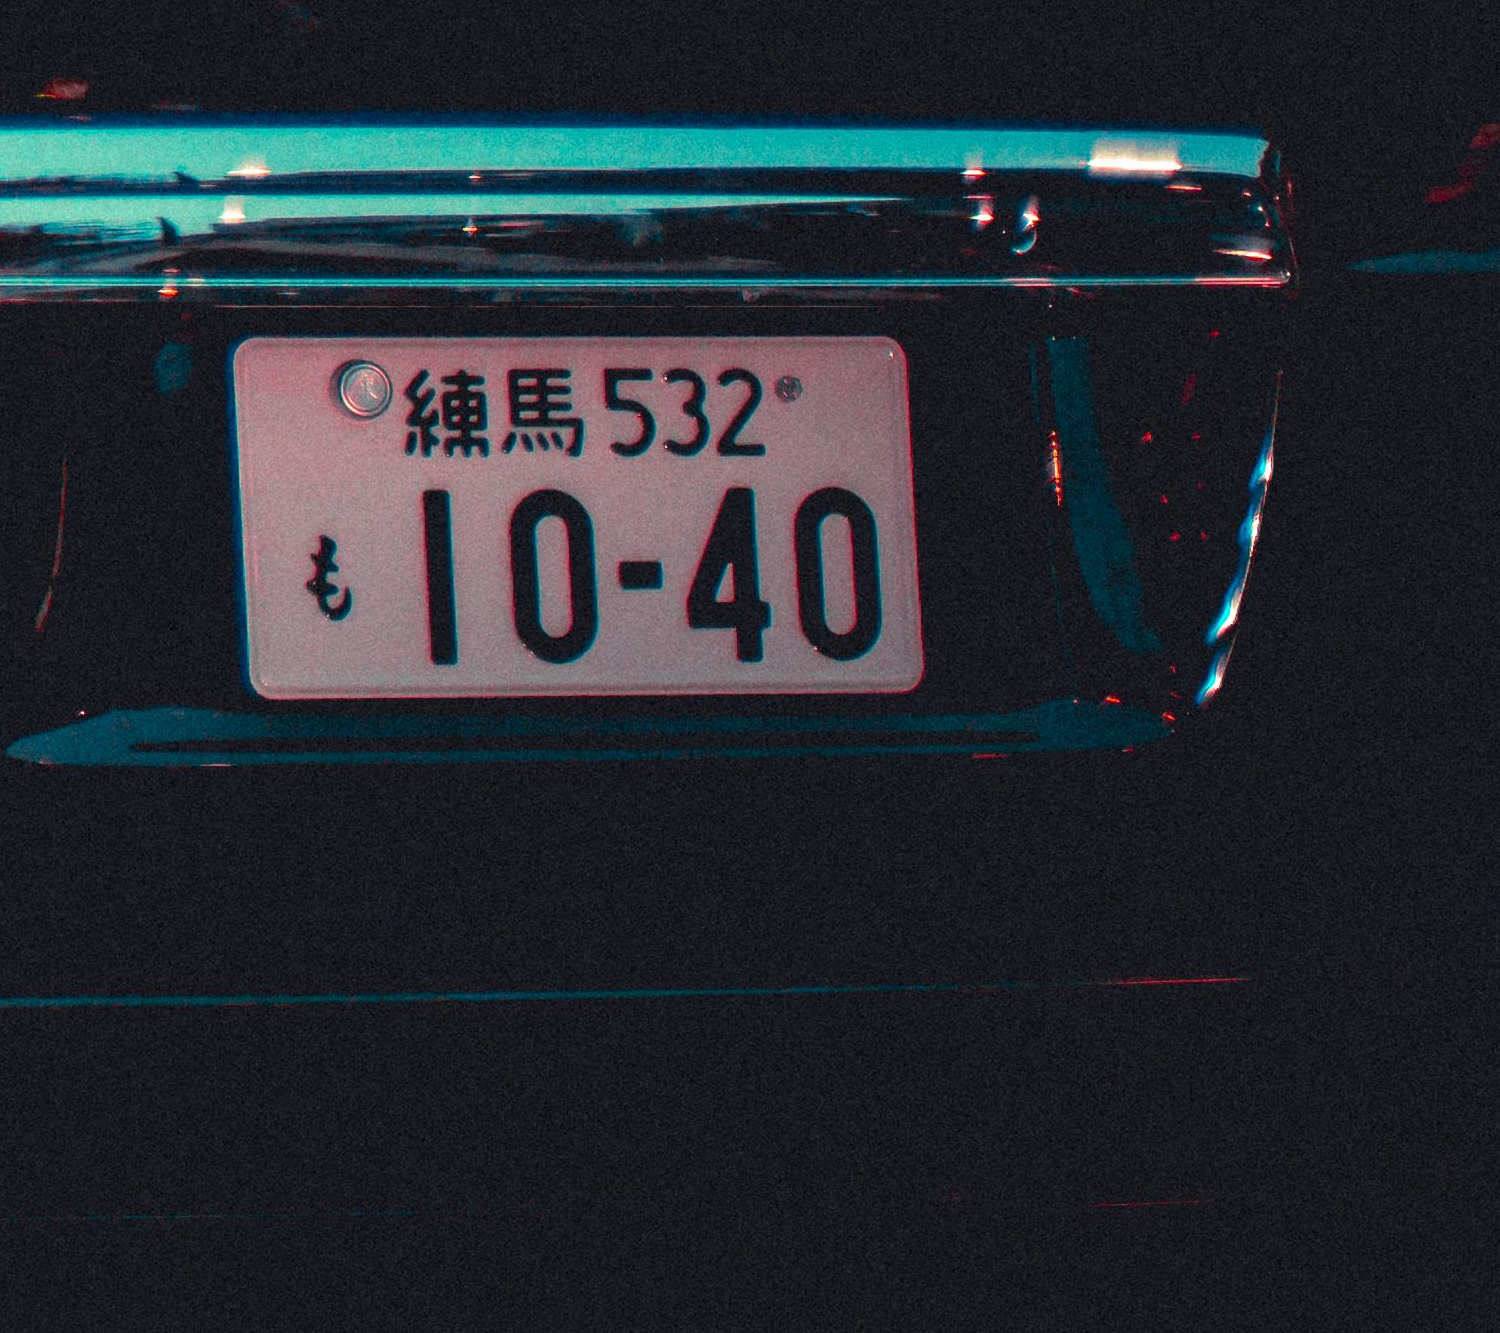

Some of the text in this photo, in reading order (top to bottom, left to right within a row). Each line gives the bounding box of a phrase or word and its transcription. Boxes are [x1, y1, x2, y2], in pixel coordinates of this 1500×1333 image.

[403, 367, 585, 459] 練馬
[603, 367, 767, 459] 532
[306, 534, 352, 622] も
[422, 486, 884, 666] 10-40
